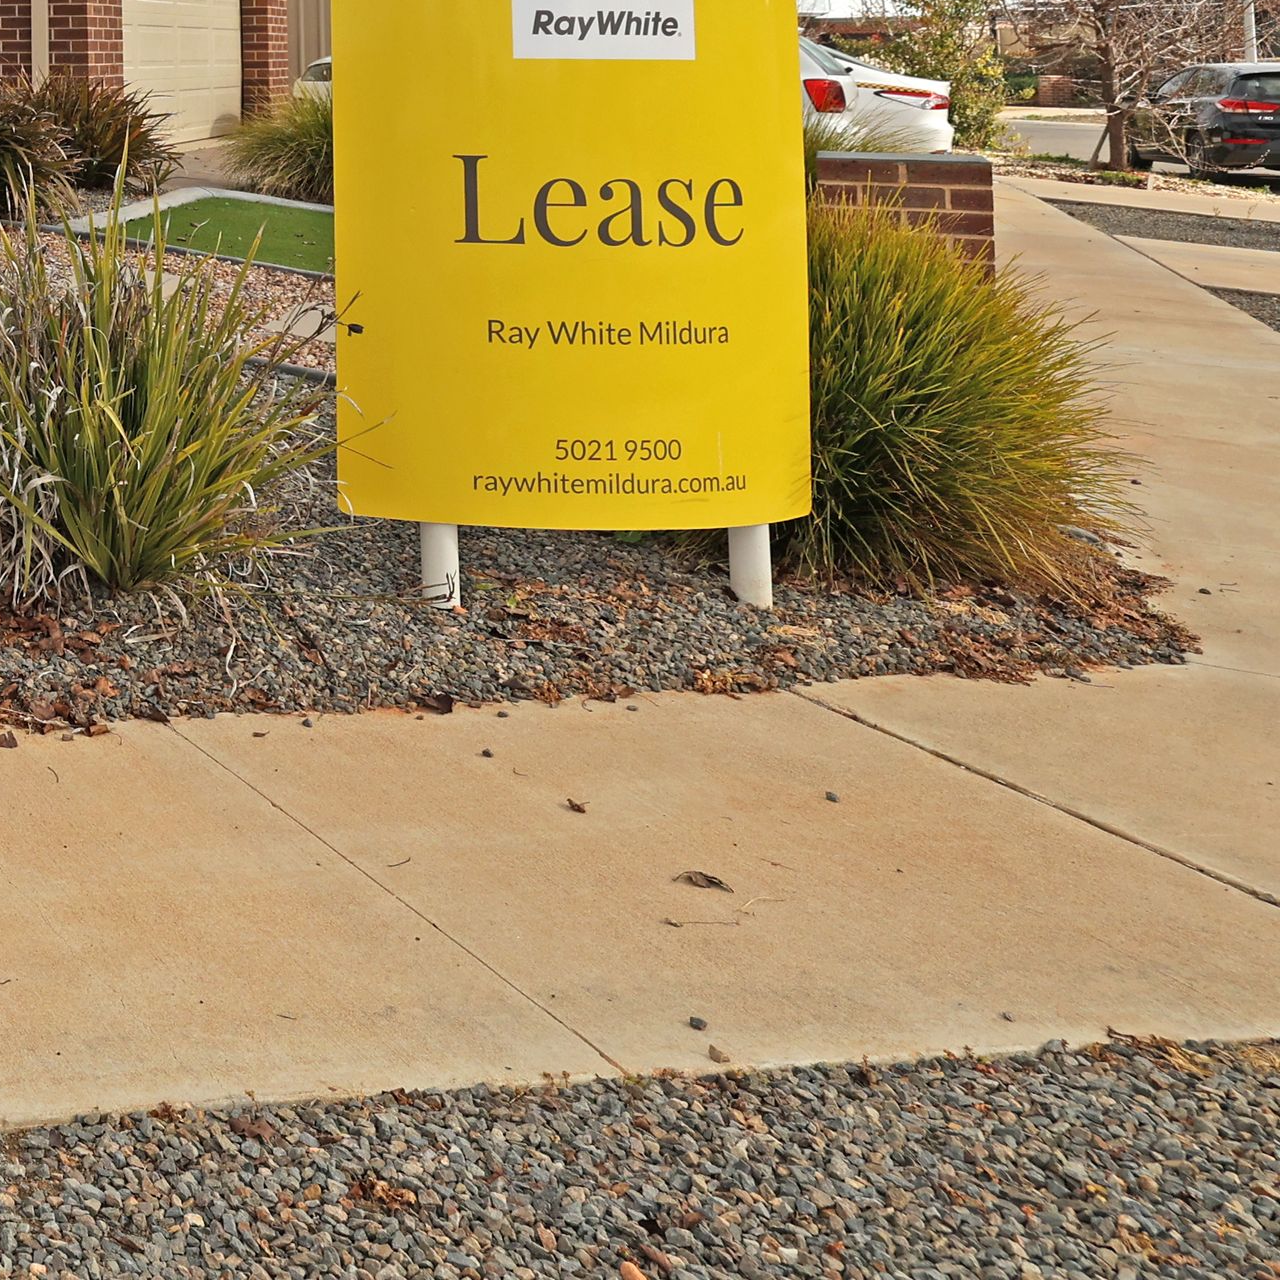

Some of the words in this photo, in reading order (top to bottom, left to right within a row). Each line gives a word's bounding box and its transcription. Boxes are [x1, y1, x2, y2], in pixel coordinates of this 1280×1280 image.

[451, 154, 744, 248] Lease
[487, 319, 541, 349] Ray
[546, 320, 632, 346] White
[639, 320, 729, 345] Mildura
[555, 439, 618, 461] 5021
[624, 439, 682, 461] 9500
[473, 471, 746, 495] raywhitemildura.com.au
